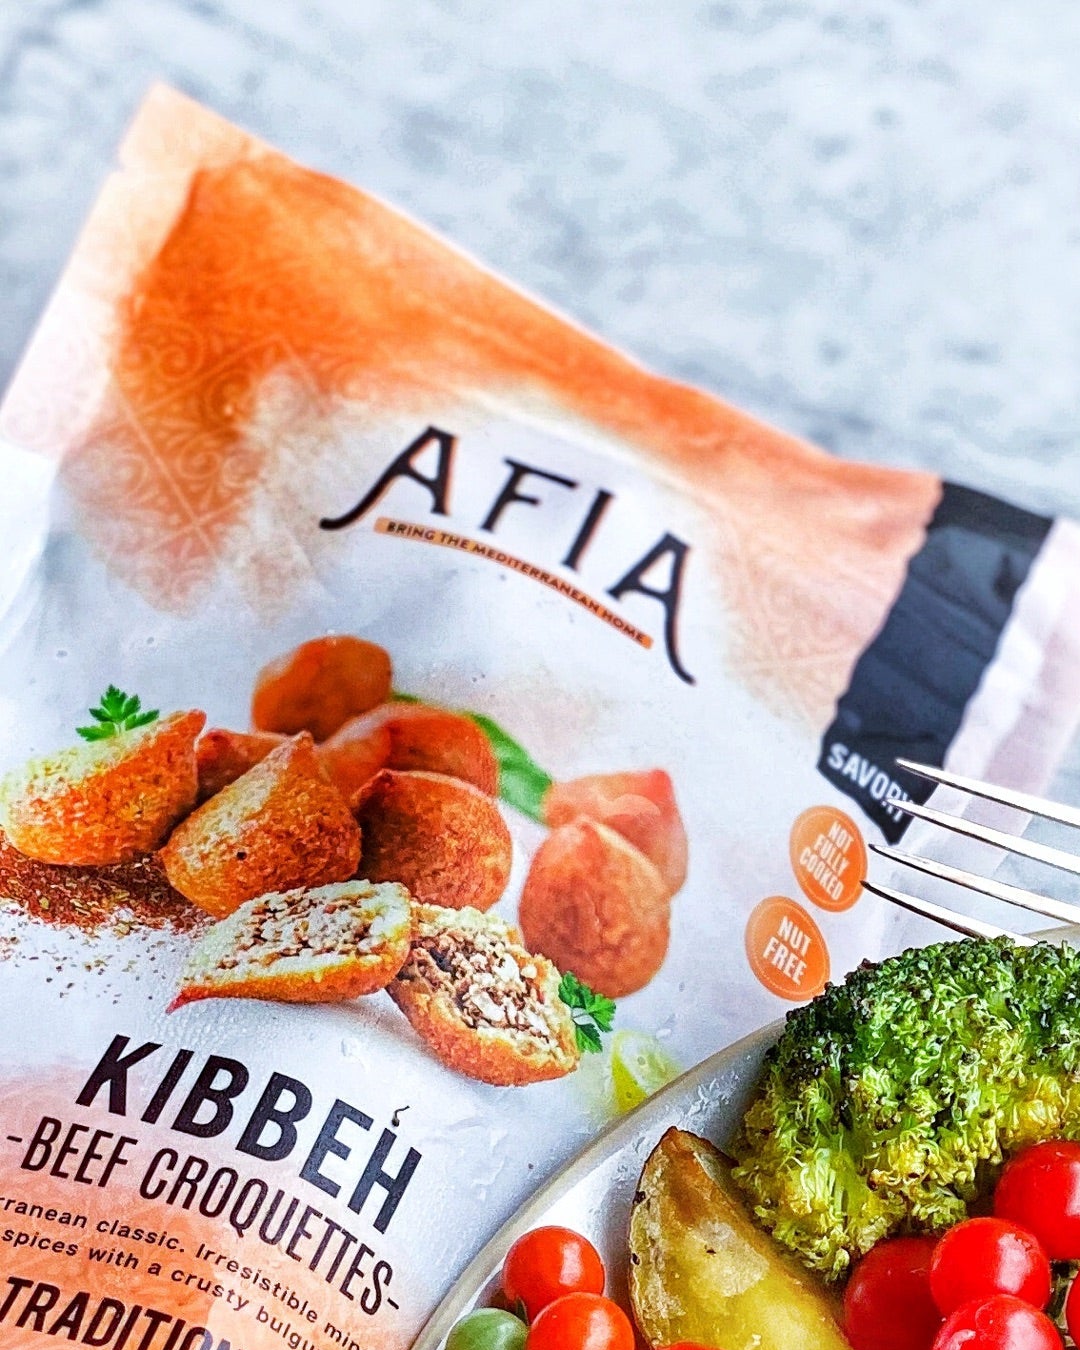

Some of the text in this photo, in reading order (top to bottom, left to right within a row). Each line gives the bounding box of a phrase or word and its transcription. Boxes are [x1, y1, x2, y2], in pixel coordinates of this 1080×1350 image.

[319, 424, 697, 687] AFIA
[386, 520, 646, 644] BRING THE MEDITERRANEAN HOME
[814, 833, 850, 876] FULLY
[828, 821, 854, 850] NOT
[799, 846, 846, 901] COOKED
[762, 937, 808, 985] FREE
[777, 915, 811, 958] NUT
[75, 1033, 423, 1234] KIBBEH
[0, 1197, 87, 1228] ranean
[96, 1217, 185, 1254] classic.
[196, 1243, 318, 1323] Irresistible
[1, 1228, 79, 1256] spices
[89, 1247, 140, 1270] with
[147, 1262, 161, 1277] a
[171, 1268, 249, 1313] crusty
